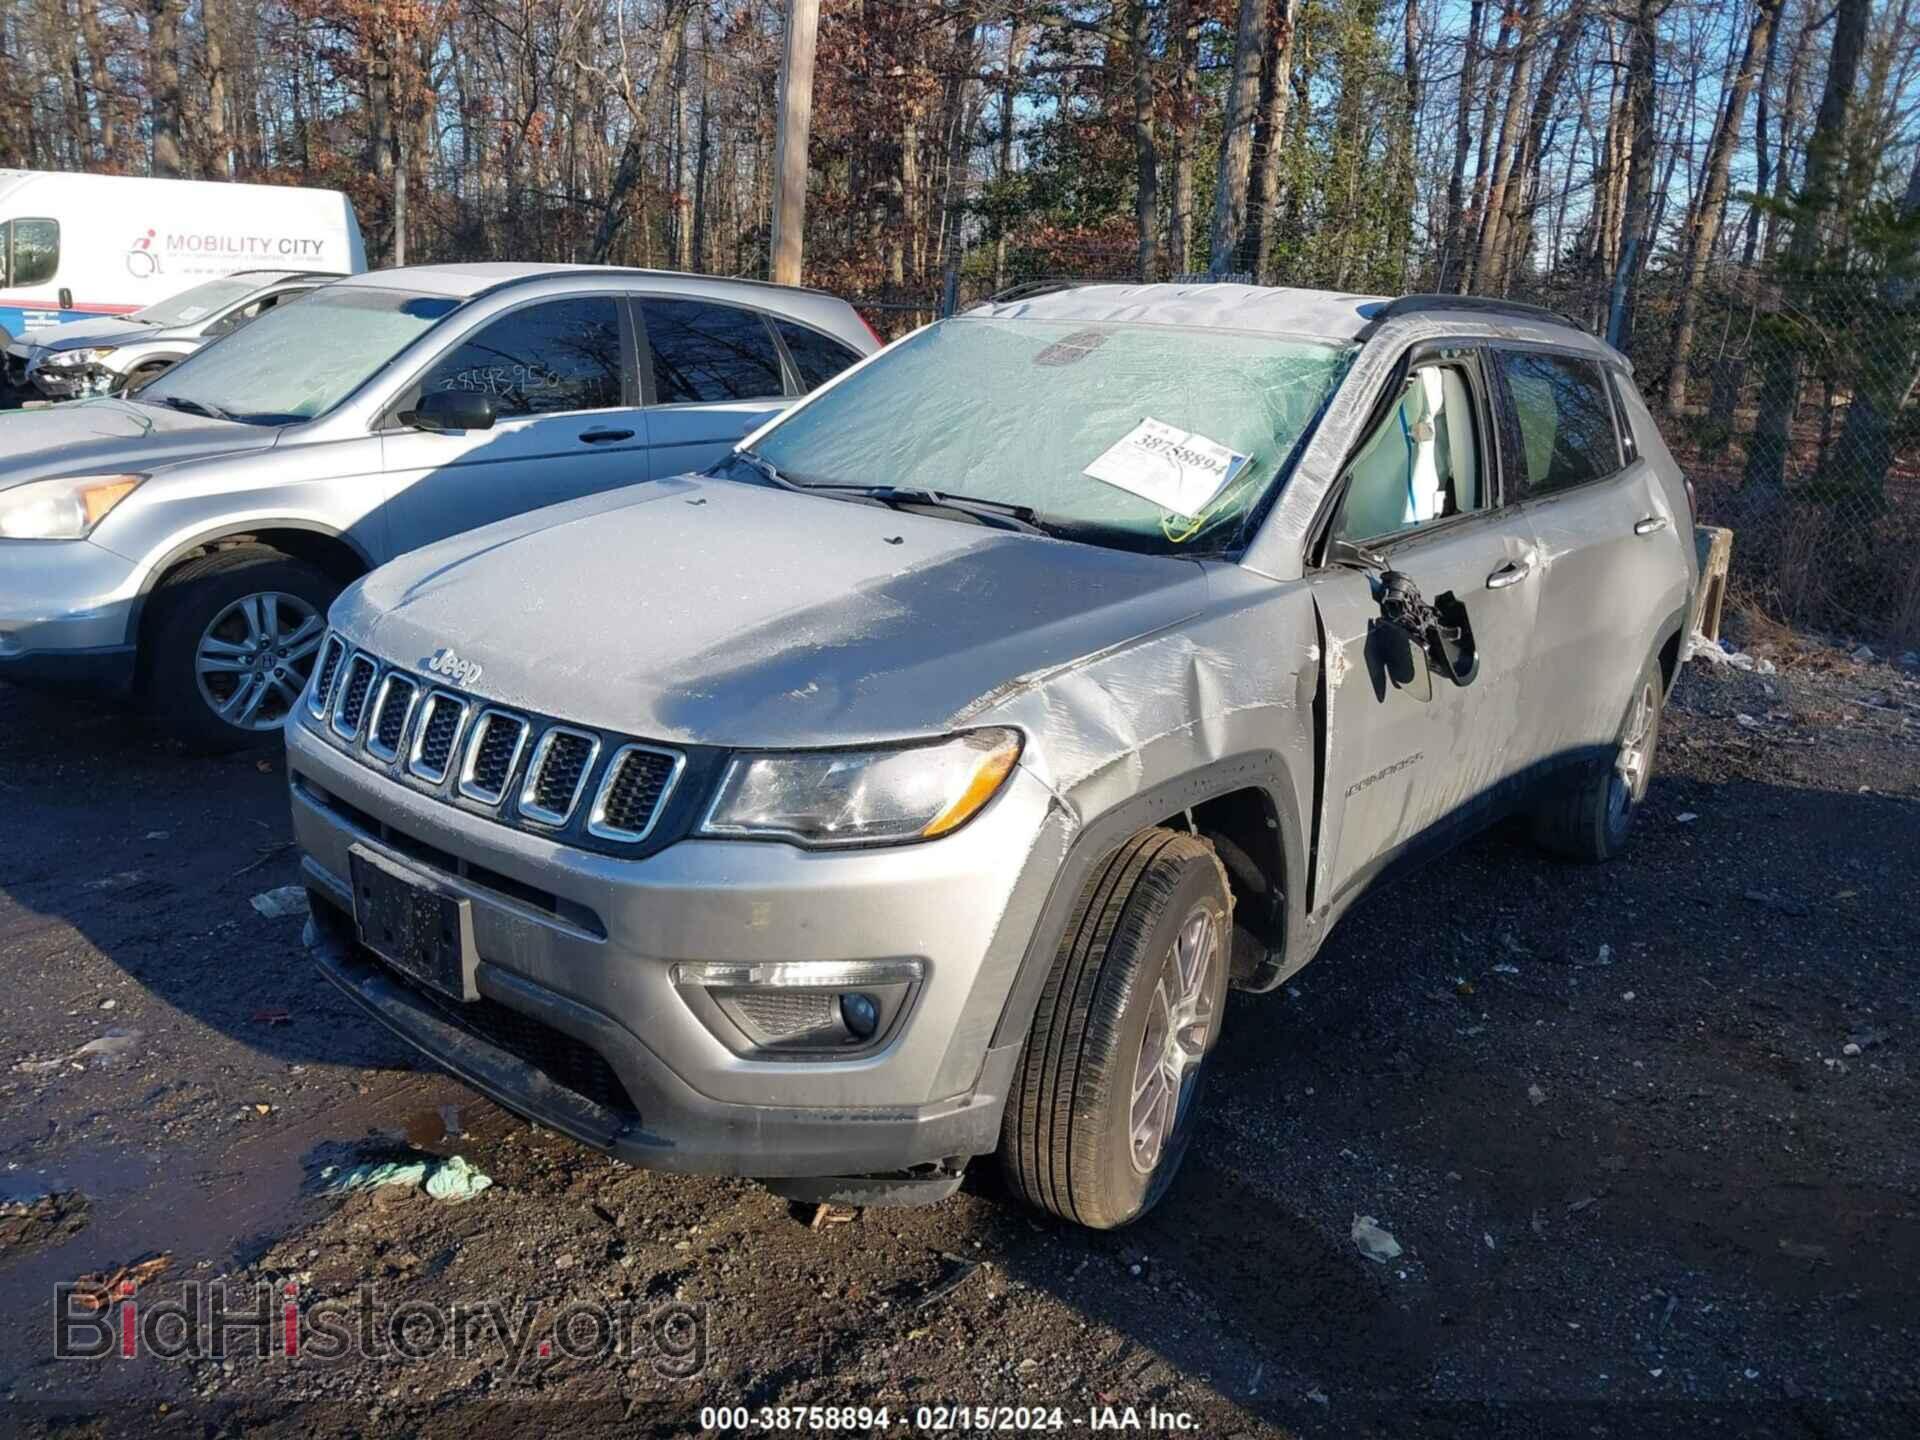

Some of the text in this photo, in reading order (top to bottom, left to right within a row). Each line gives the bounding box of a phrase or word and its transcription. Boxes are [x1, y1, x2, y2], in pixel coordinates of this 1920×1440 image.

[167, 234, 324, 255] MOBILITY CITY
[1135, 434, 1227, 476] 38758894
[428, 648, 482, 687] Jeep
